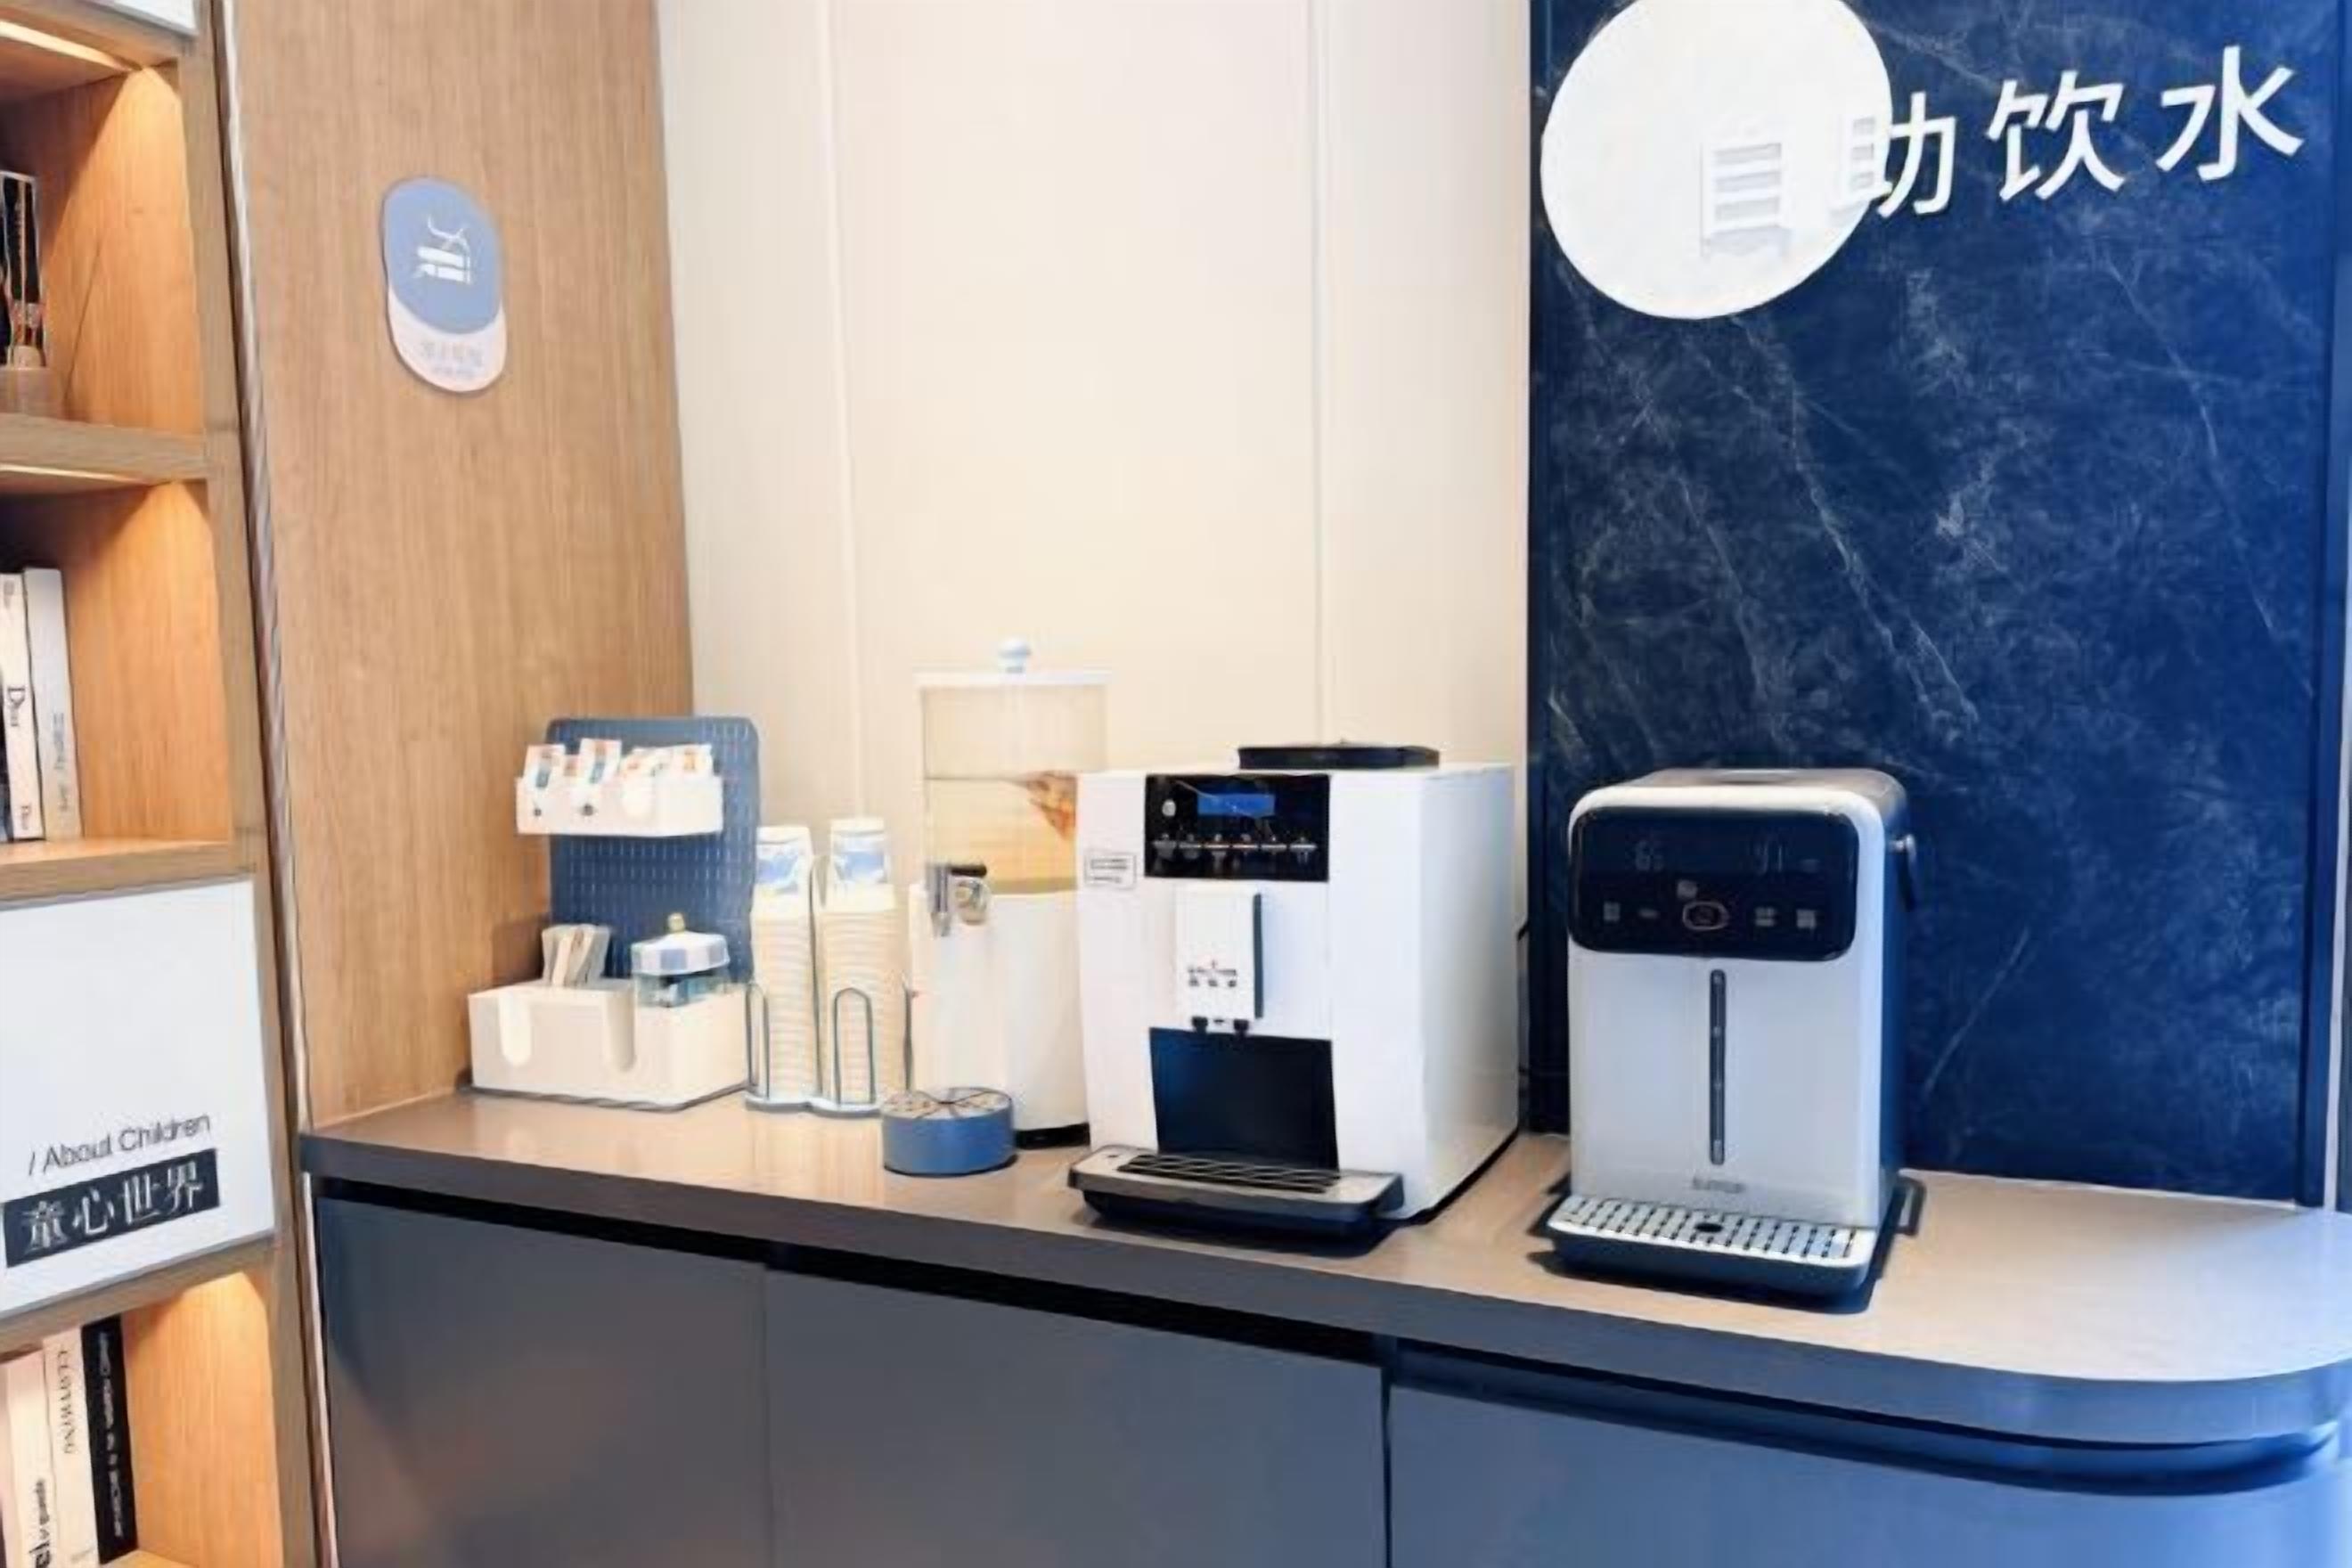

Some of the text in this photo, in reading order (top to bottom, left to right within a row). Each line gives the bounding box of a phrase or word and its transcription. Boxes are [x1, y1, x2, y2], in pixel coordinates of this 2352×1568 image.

[43, 1134, 111, 1172] About
[118, 1115, 211, 1151] Children
[23, 1160, 203, 1250] 童心世界
